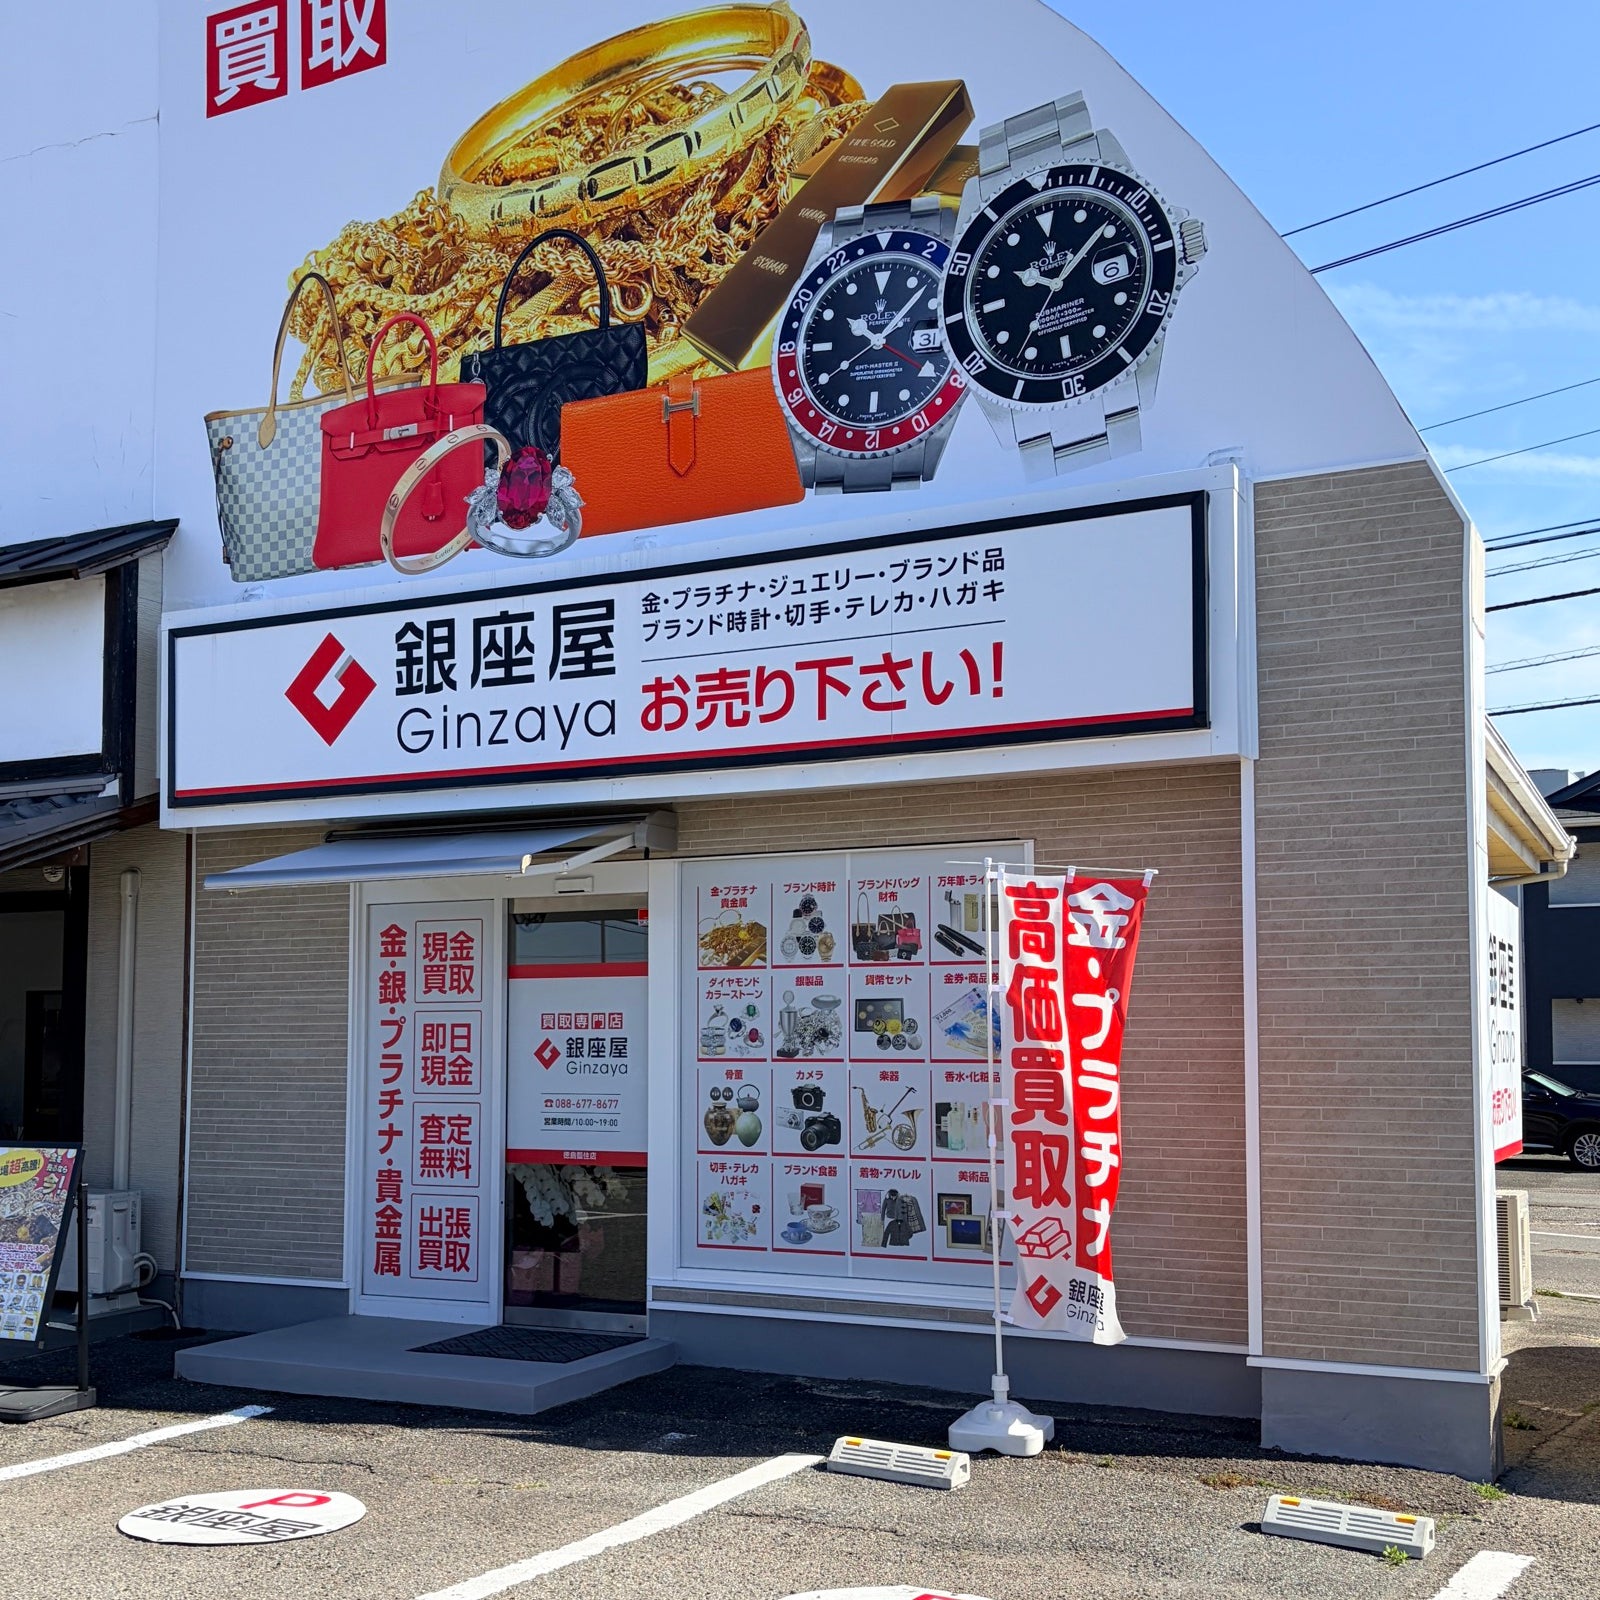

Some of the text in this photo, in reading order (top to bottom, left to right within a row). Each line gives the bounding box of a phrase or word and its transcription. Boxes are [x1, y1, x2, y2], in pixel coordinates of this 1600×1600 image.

[212, 0, 381, 107] 買取
[921, 241, 938, 259] 2
[826, 250, 850, 274] 22
[950, 252, 971, 276] 50
[1103, 261, 1120, 278] 6
[792, 288, 814, 313] 20
[1035, 298, 1085, 318] SUBMARINER
[1146, 289, 1170, 316] 20
[860, 311, 899, 321] ROLEX
[779, 340, 797, 358] 18
[918, 333, 938, 347] 31
[962, 351, 987, 376] 40
[787, 387, 806, 409] 16
[1062, 374, 1087, 400] 30
[817, 419, 838, 442] 14
[911, 410, 931, 433] 10
[864, 430, 880, 449] 12
[641, 547, 1005, 616] 金・プラチナ・ジュエリー・ブランド品
[642, 579, 1005, 642] ブランド時計・切手・テレカ・ハガキ
[395, 599, 616, 696] 銀座屋
[640, 641, 1004, 732] お売り下さい!
[397, 699, 616, 754] Ginzaya
[710, 884, 758, 897] 金・プラチナ
[783, 881, 836, 893] ブランド時計
[857, 877, 920, 890] ブランドバッグ
[720, 897, 748, 909] 貴金属
[878, 891, 898, 902] 財布
[423, 930, 475, 962] 現金
[422, 964, 475, 995] 買取
[709, 977, 760, 988] ダイヤモンド
[795, 975, 824, 987] 銀製品
[865, 974, 912, 986] 貨幣セット
[705, 989, 763, 1000] カラーストーン
[542, 1013, 622, 1029] 買取専門店
[421, 1023, 472, 1054] 即日
[566, 1037, 628, 1059] 銀座屋
[1005, 881, 1071, 1209] 高価買取
[421, 1055, 473, 1087] 現金
[566, 1060, 628, 1077] Ginzaya
[725, 1069, 743, 1080] 骨董
[796, 1070, 824, 1080] カメラ
[879, 1071, 899, 1082] 楽器
[1067, 882, 1134, 1256] 金・プラチナ
[374, 923, 407, 1276] 金・銀・プラチナ・貴金属
[555, 1099, 619, 1109] 088-677-8677
[420, 1113, 472, 1145] 査定
[419, 1147, 472, 1179] 無料
[709, 1163, 759, 1174] 切手・テレカ
[784, 1165, 837, 1177] ブランド食器
[721, 1175, 747, 1186] ハガキ
[958, 1170, 989, 1182] 美術品
[419, 1206, 471, 1239] 出張
[417, 1240, 470, 1273] 買取
[238, 1493, 331, 1509] P
[131, 1504, 323, 1539] 銀座屋
